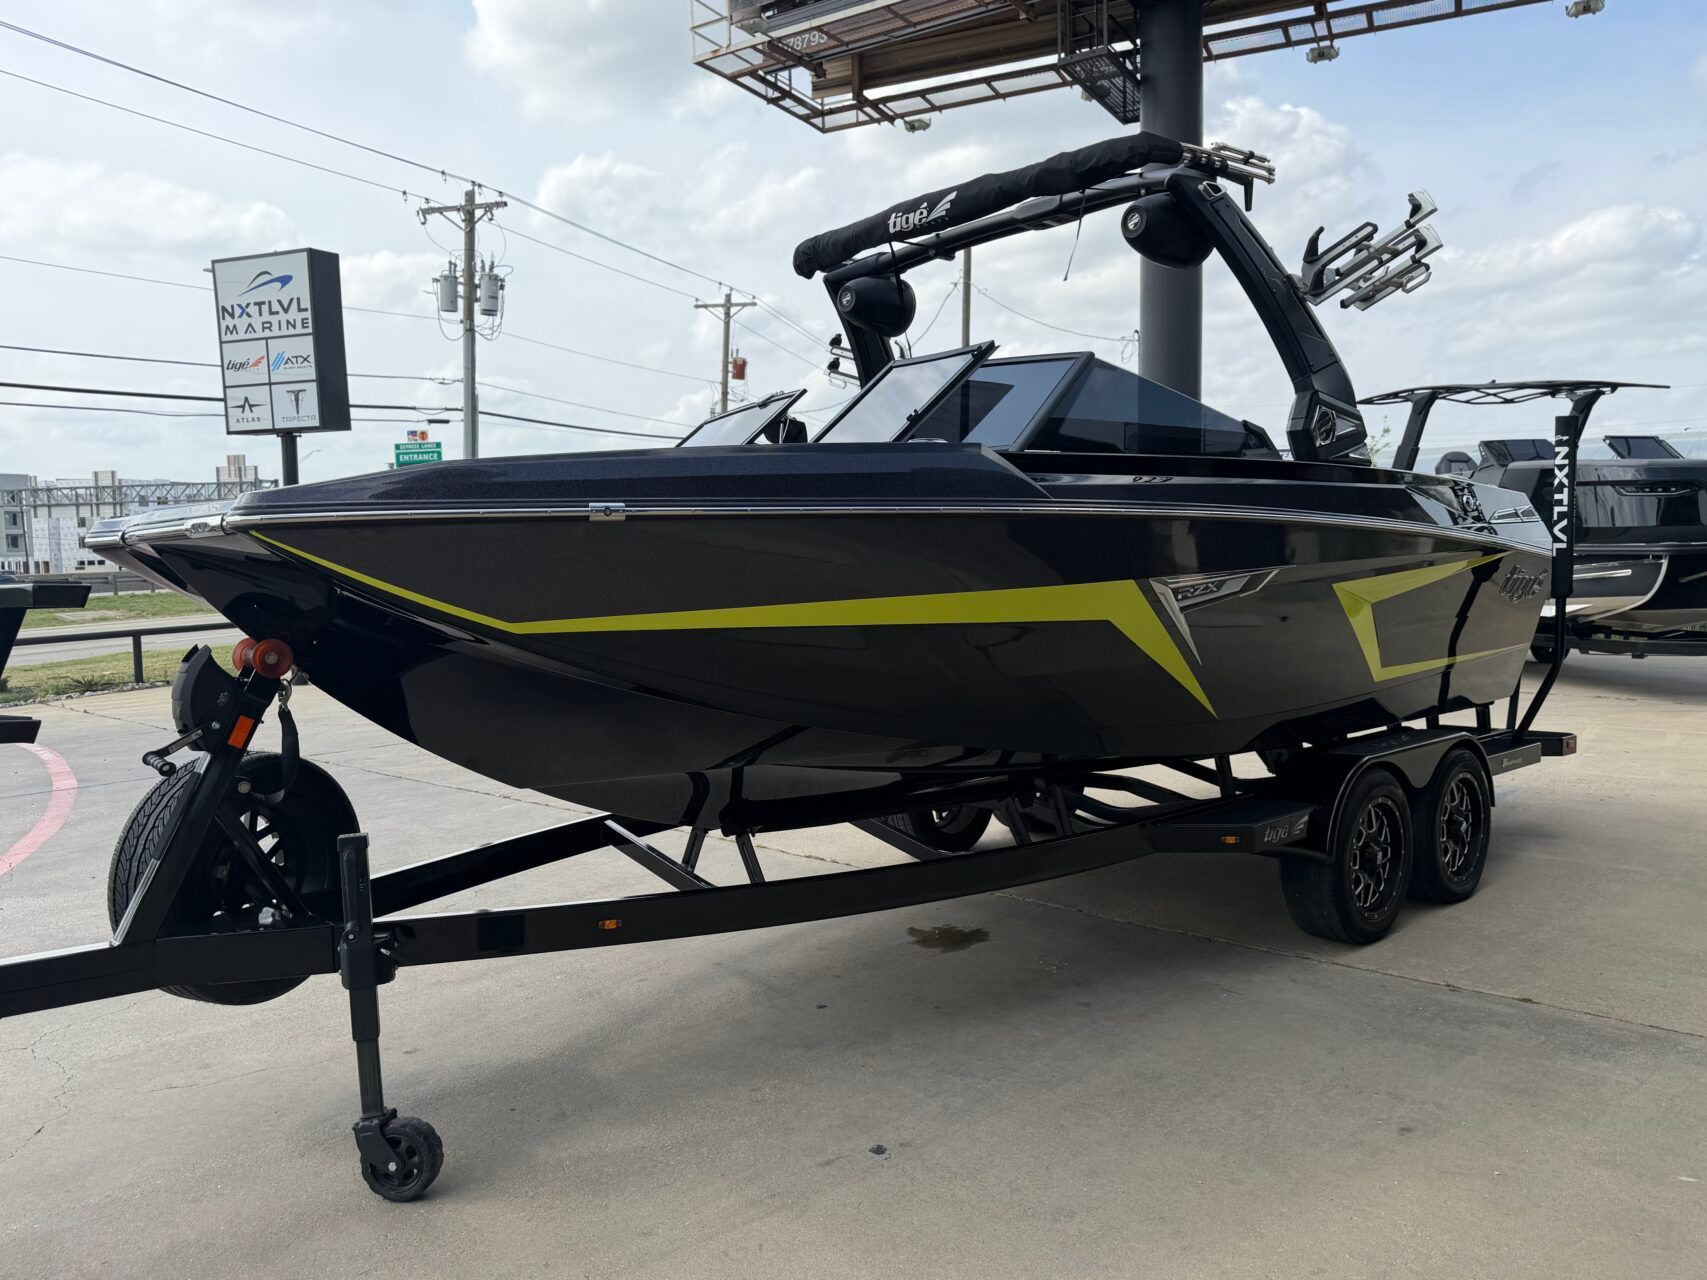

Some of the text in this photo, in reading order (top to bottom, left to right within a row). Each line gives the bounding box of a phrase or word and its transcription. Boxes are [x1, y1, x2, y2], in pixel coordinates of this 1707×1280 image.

[888, 202, 928, 233] tigé
[221, 297, 309, 320] NXTLVL
[225, 317, 310, 336] MARINE
[226, 358, 250, 372] tigé
[283, 354, 311, 366] ATX
[281, 415, 316, 423] TRIFECTA
[399, 453, 438, 461] ENTRANCE
[1552, 446, 1569, 557] NXTLVL
[1177, 581, 1218, 600] RZX
